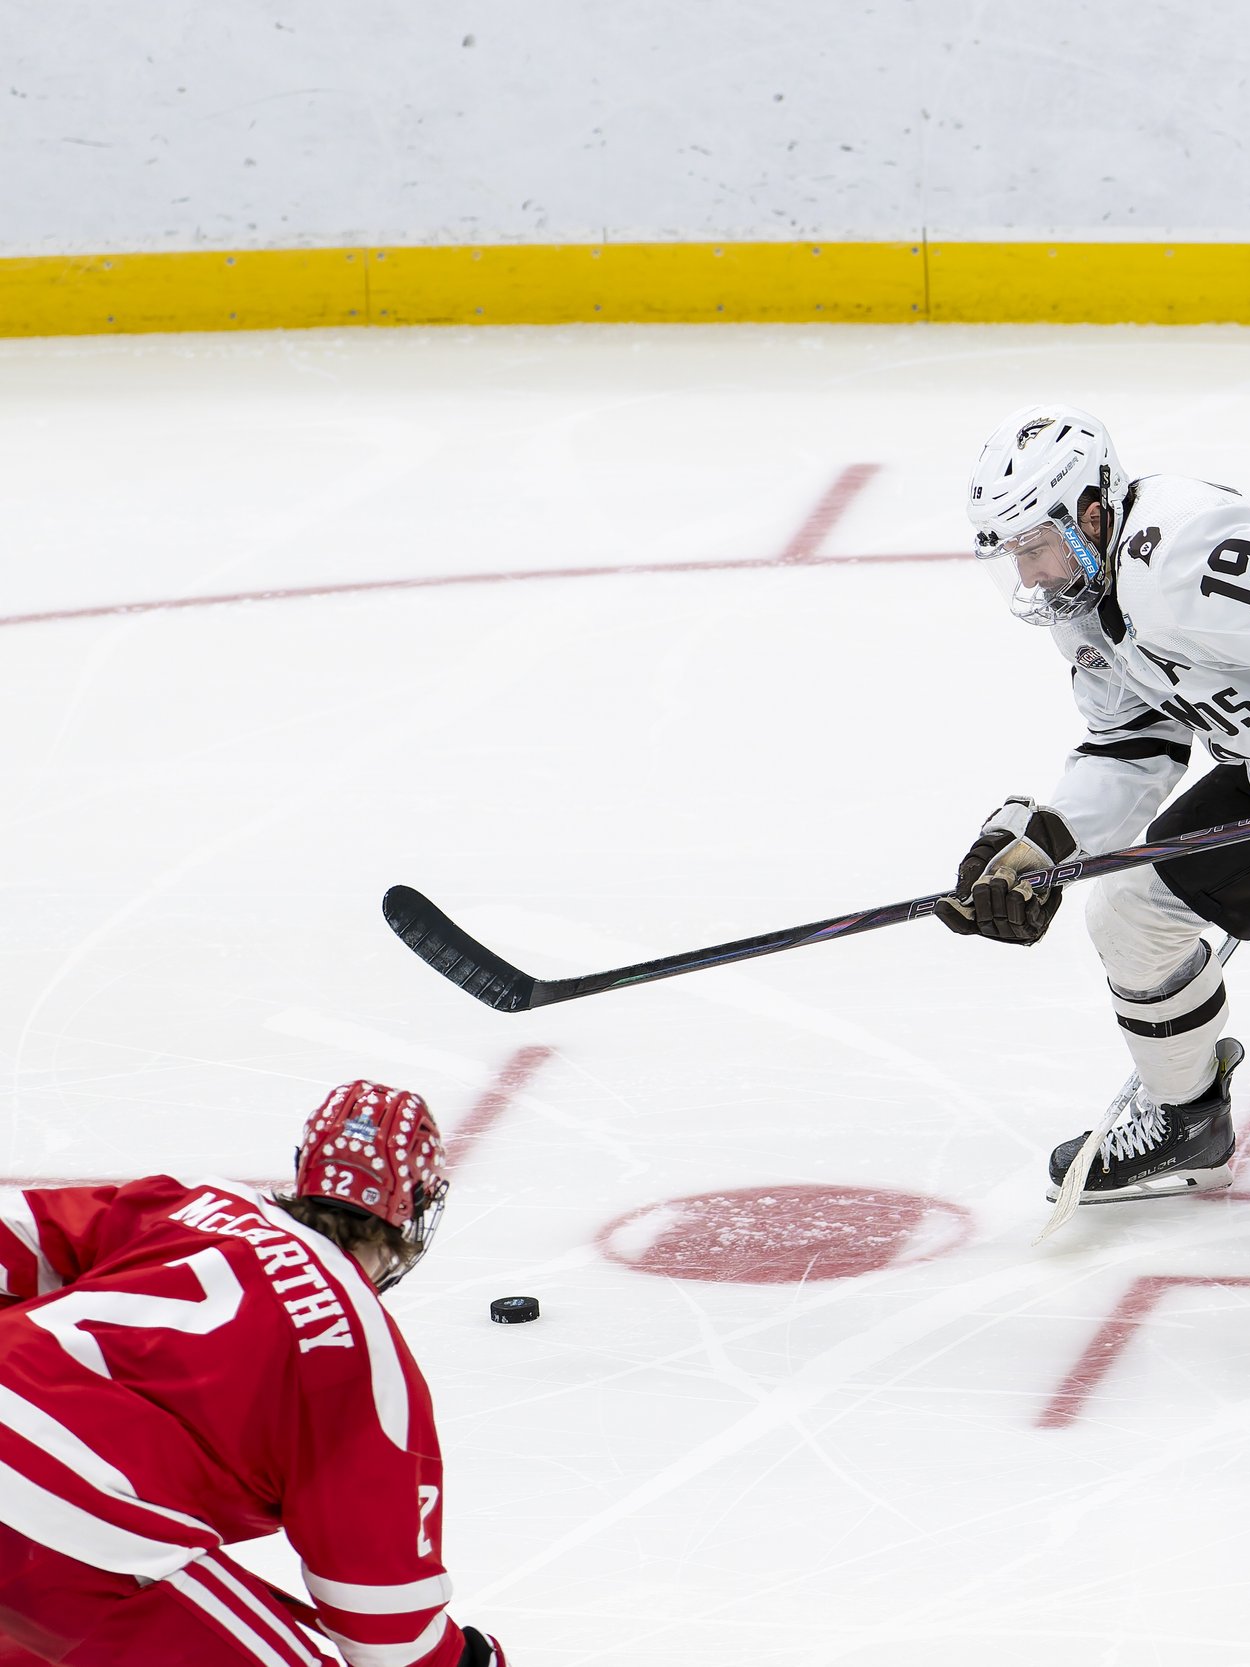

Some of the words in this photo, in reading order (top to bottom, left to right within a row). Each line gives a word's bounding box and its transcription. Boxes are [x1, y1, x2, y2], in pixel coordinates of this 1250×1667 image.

[972, 486, 983, 499] 19
[1136, 644, 1192, 686] A
[335, 1170, 354, 1197] 2
[417, 1485, 439, 1558] 2
